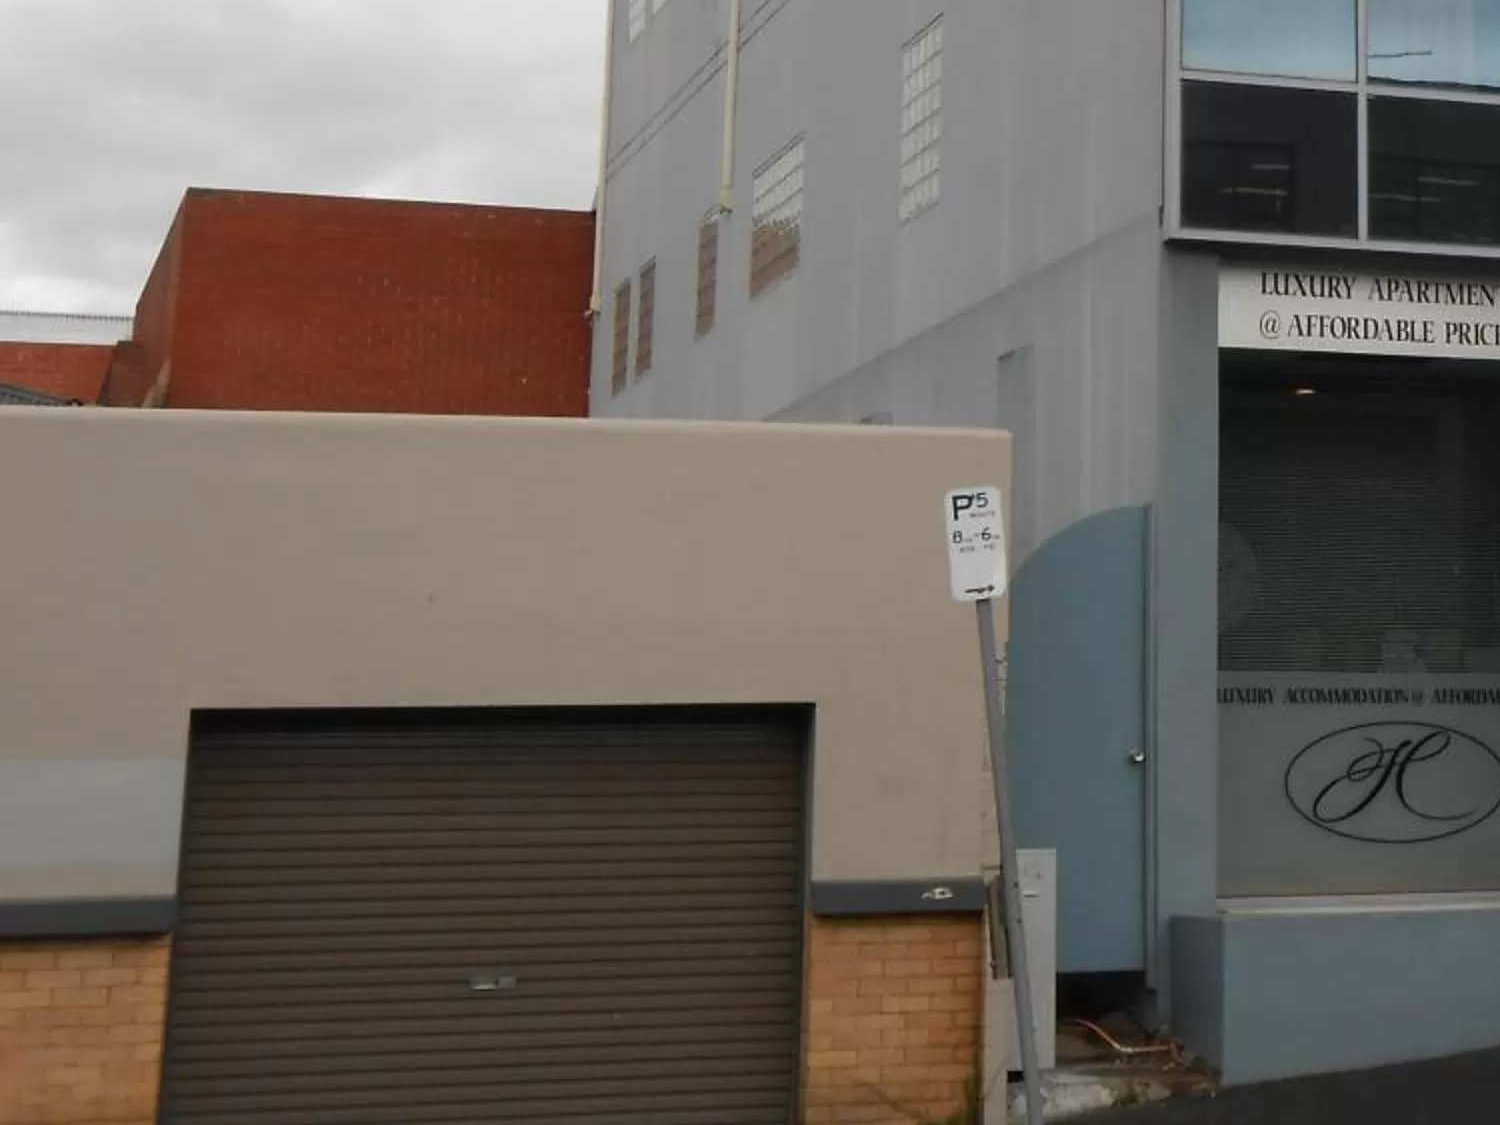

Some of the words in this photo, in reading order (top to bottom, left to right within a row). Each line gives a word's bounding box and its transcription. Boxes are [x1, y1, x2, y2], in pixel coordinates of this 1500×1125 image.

[1259, 270, 1357, 301] LUXURY
[1259, 309, 1281, 340] @
[1287, 313, 1436, 344] AFFORDABLE
